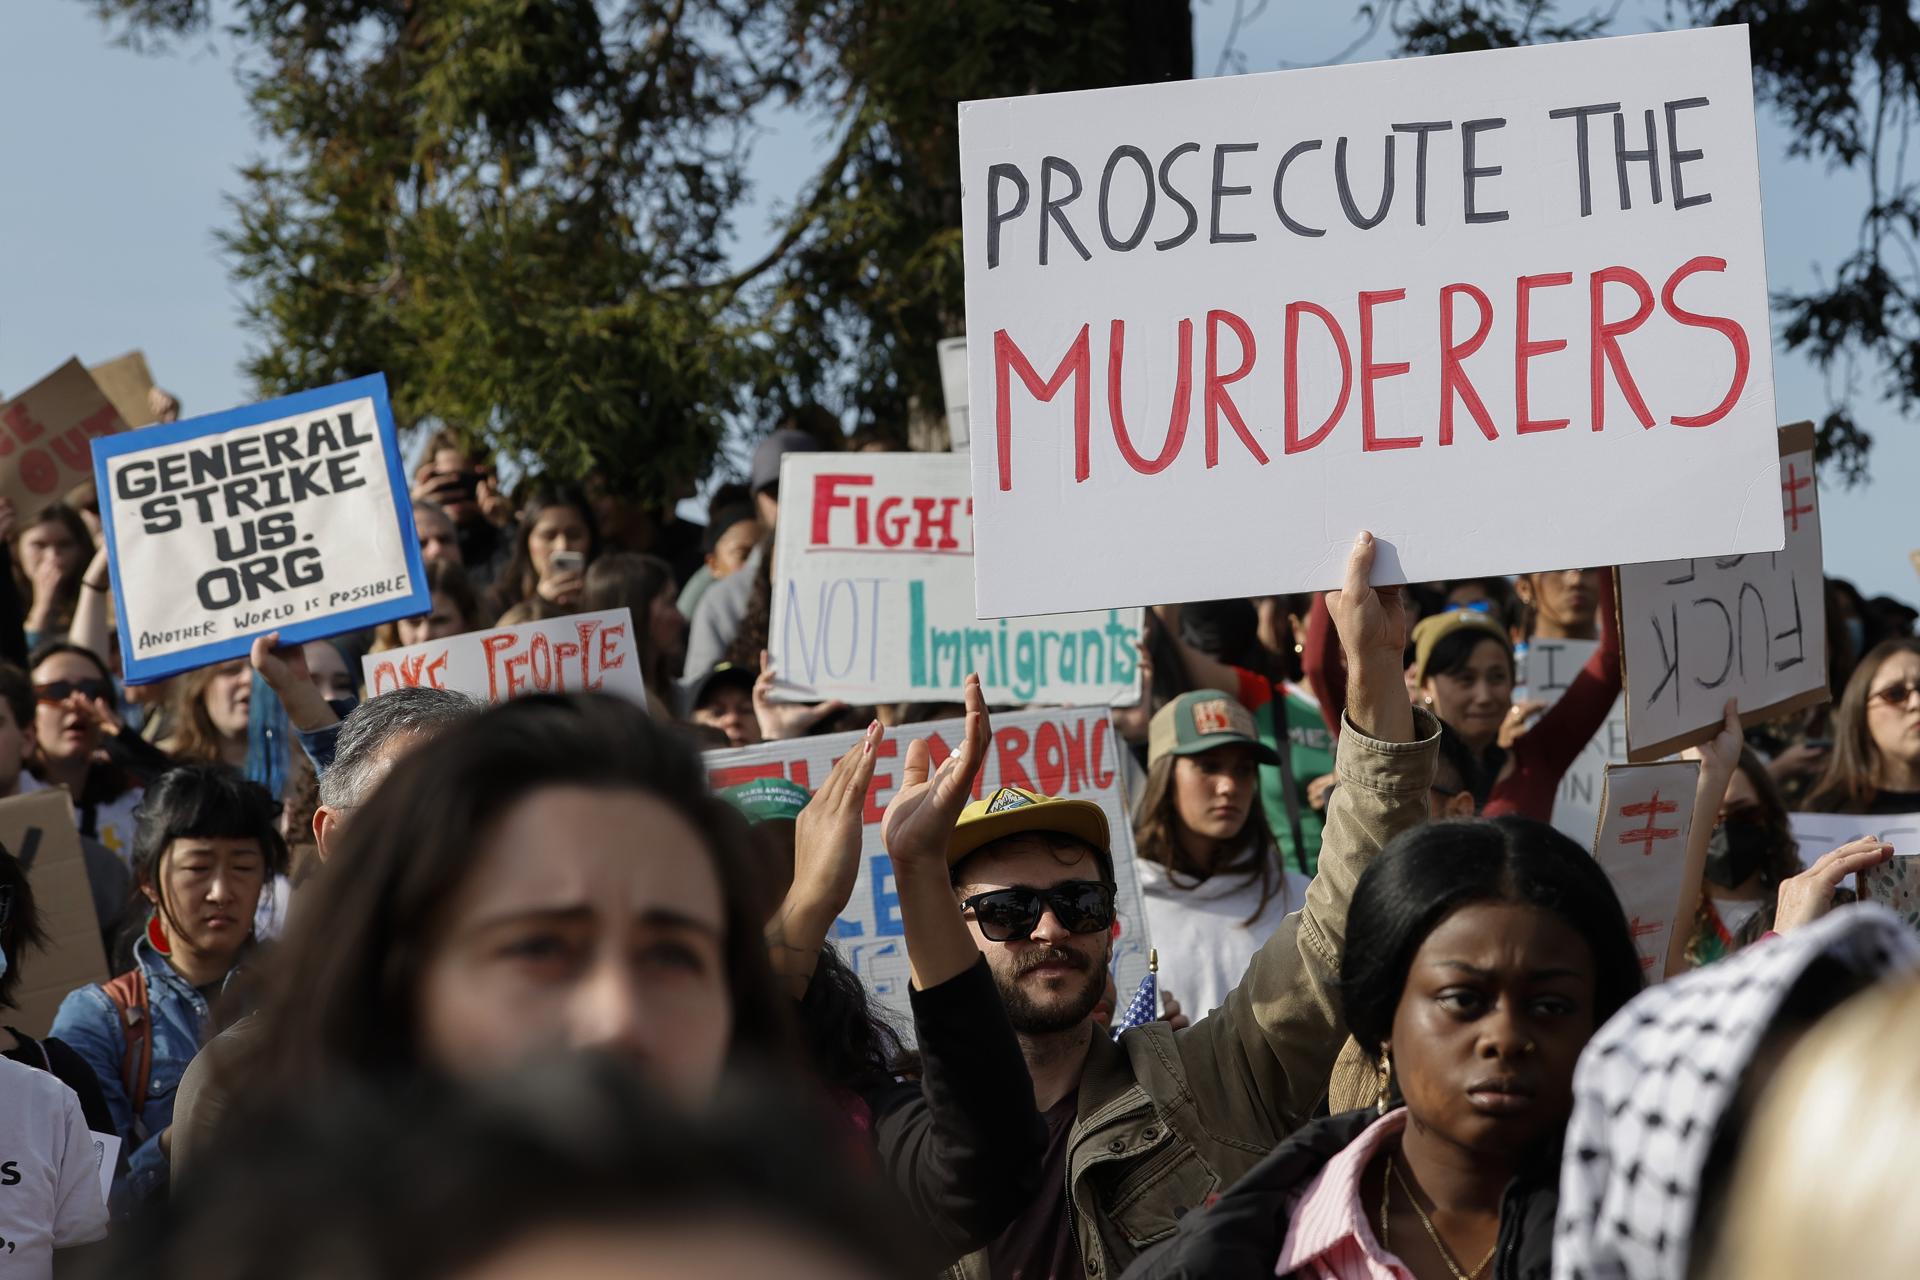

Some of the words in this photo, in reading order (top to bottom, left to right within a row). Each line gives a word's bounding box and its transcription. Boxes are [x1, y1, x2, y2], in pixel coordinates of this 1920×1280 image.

[987, 118, 1509, 269] PROSECUTE
[1549, 97, 1713, 217] THE
[994, 256, 1750, 491] MURDERERS
[116, 412, 373, 500] GENERAL
[140, 451, 367, 535] STRIKE
[213, 511, 315, 562] US.
[811, 474, 974, 550] FIGH
[138, 621, 218, 650] ANOTHER
[233, 604, 295, 630] WORLD
[329, 575, 407, 607] POSSIBLE
[196, 547, 324, 611] ORG
[481, 619, 626, 704] PEOPLE
[784, 578, 890, 684] NOT
[909, 580, 1140, 700] Immigrants
[1646, 570, 1807, 717] FUCK
